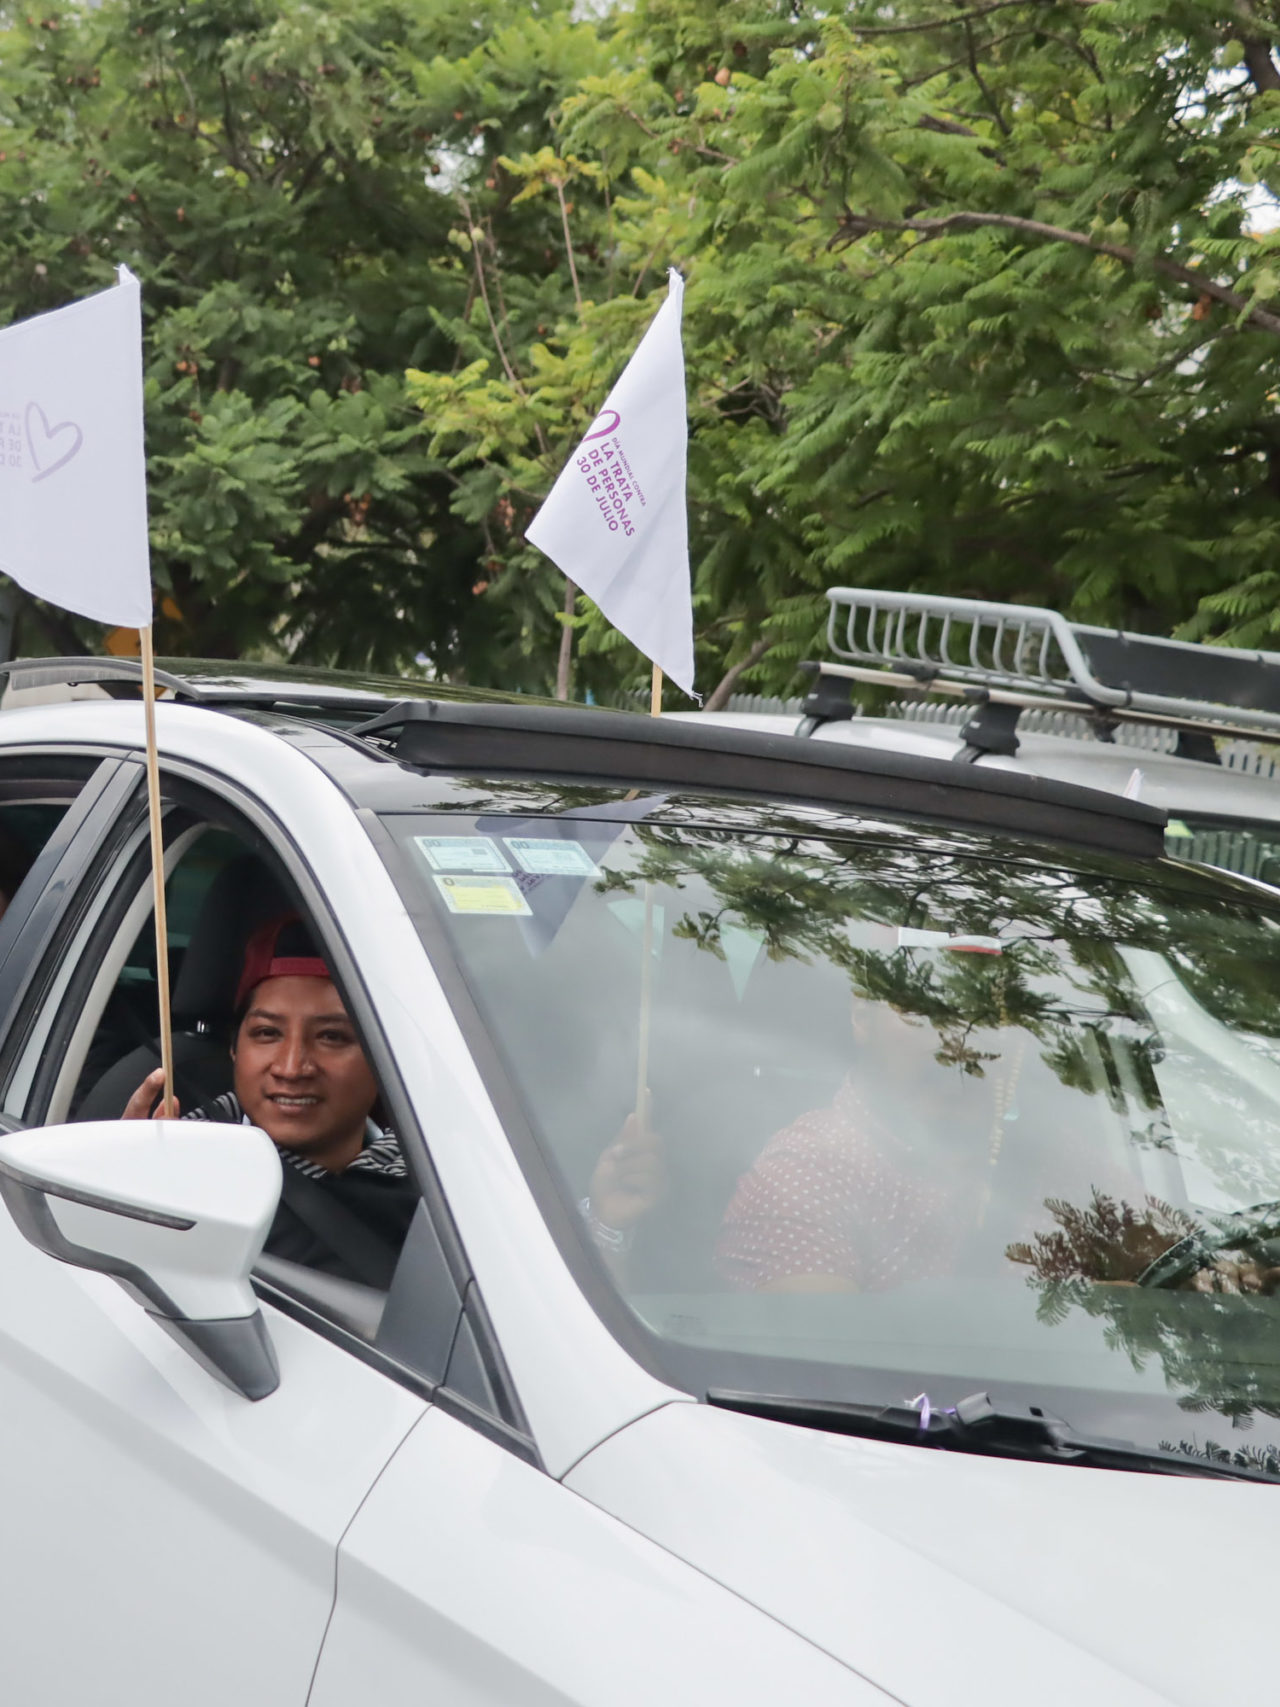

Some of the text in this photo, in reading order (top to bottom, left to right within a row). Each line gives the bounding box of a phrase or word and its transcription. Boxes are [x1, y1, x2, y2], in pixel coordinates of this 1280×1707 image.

[576, 456, 619, 531] 30 DE JULIO
[588, 449, 635, 537] DE PERSONAS
[600, 442, 633, 502] LA TRATA
